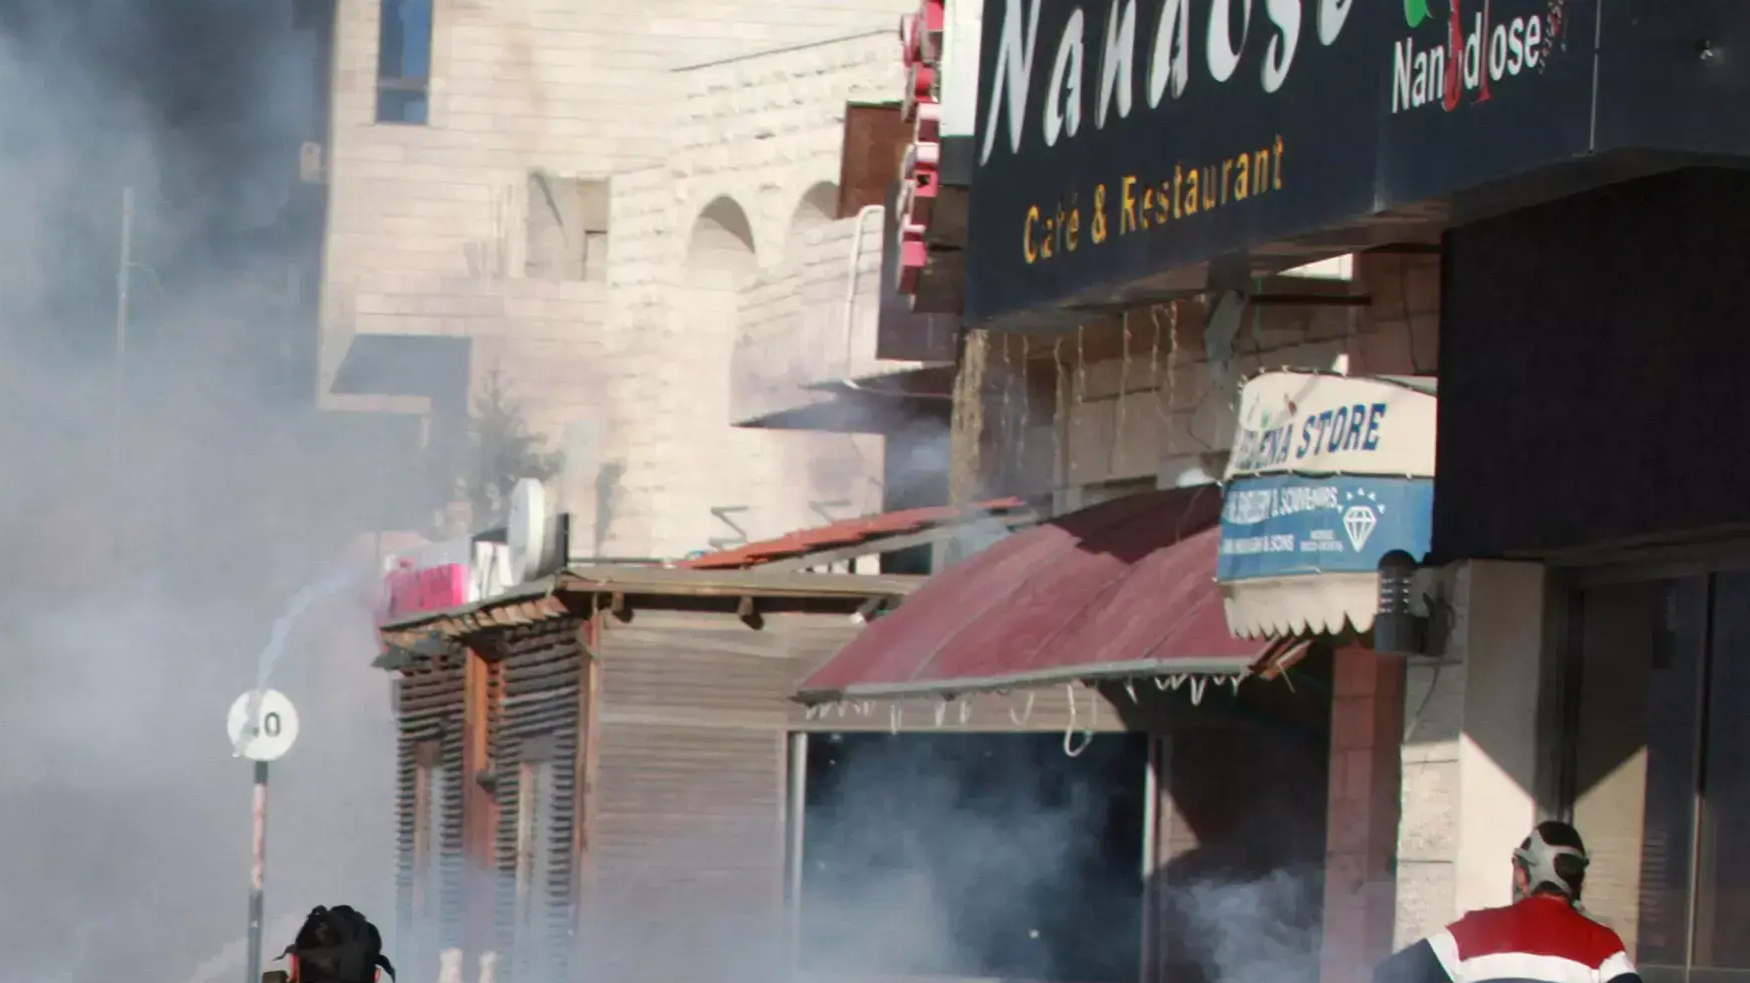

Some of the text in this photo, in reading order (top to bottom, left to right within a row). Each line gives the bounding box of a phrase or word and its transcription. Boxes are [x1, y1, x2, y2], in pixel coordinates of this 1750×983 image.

[1091, 184, 1107, 245] &
[1120, 133, 1284, 235] Restaurant
[1296, 402, 1387, 459] STORE
